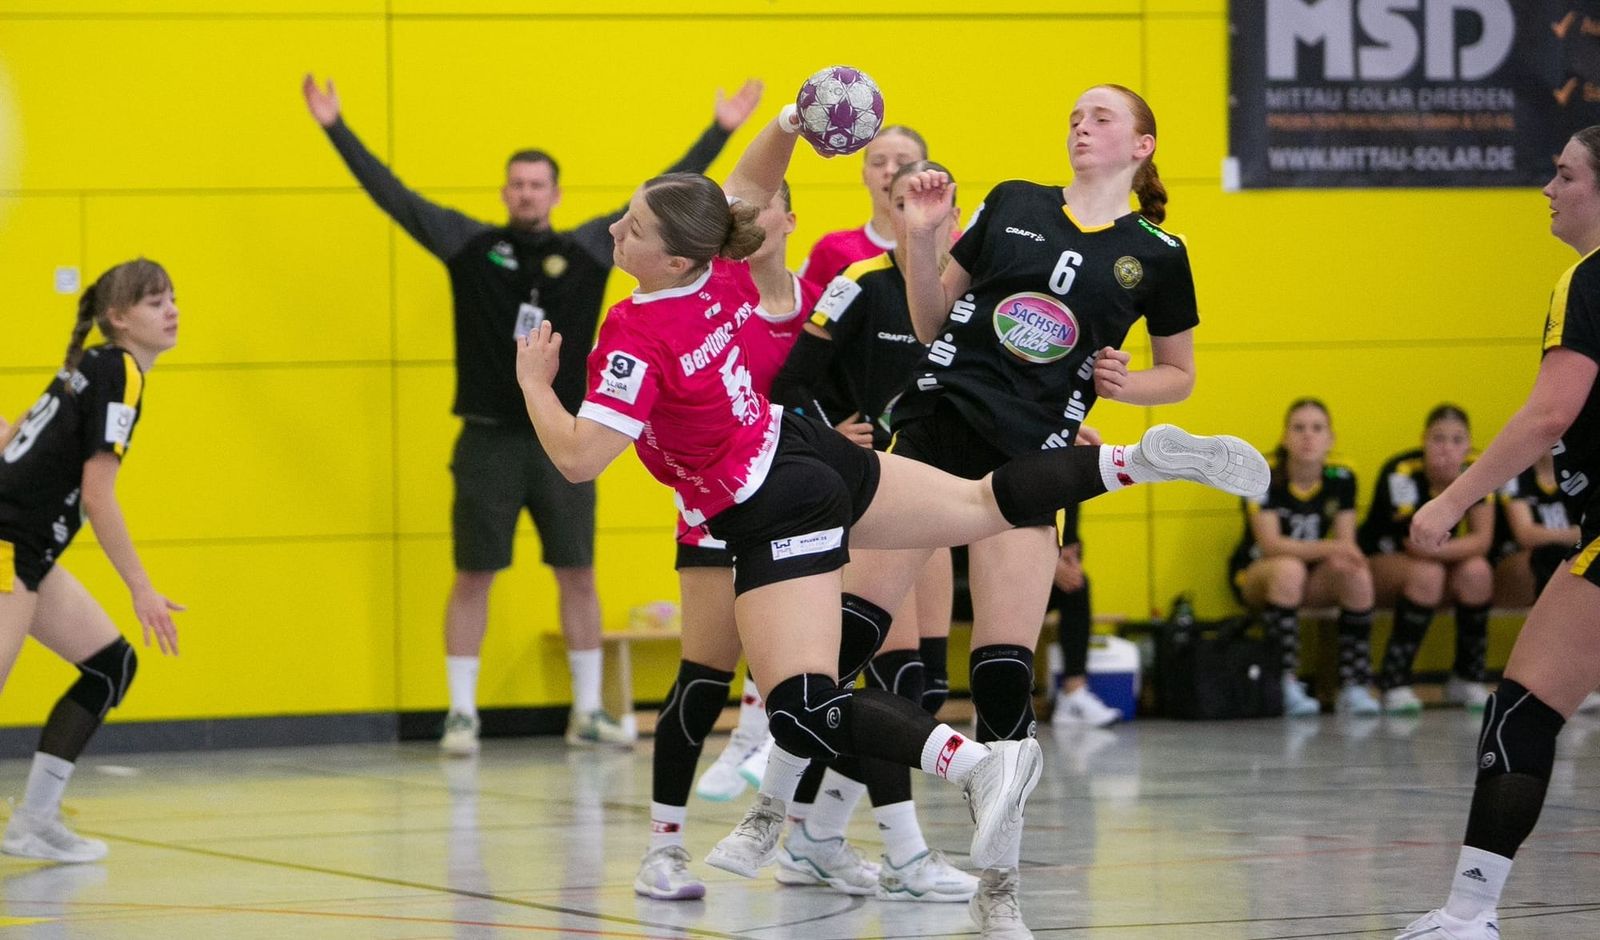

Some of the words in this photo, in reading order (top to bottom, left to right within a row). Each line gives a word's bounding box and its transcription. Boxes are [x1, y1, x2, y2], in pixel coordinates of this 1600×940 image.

[1265, 0, 1515, 81] MSD
[1265, 87, 1342, 110] MITTAU
[1346, 87, 1414, 111] SOLAR
[1418, 87, 1516, 111] DRESDEN
[1267, 146, 1515, 172] WWW.MITTAU-SOLAR.DE
[1005, 226, 1037, 239] CRAFT
[1048, 250, 1083, 296] 6
[1008, 302, 1072, 341] SACHSEN
[1000, 323, 1050, 353] Milch
